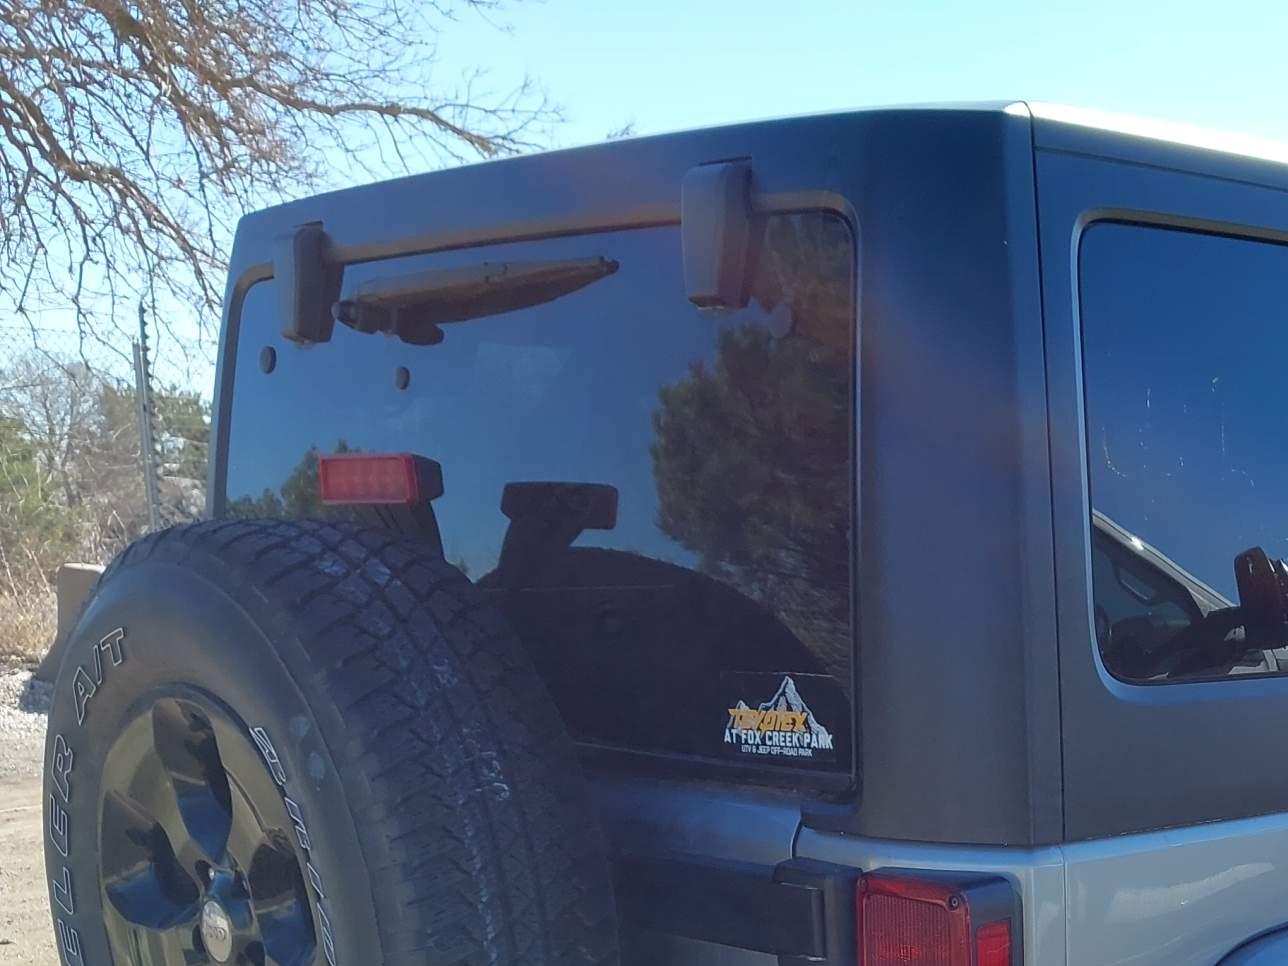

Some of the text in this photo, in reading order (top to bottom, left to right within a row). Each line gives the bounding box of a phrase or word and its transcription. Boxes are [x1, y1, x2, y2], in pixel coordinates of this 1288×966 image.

[73, 626, 126, 725] A/T
[724, 730, 833, 750] AT FOX CREEK PARK
[757, 746, 770, 754] JEEP
[770, 747, 798, 756] OFF-ROAD
